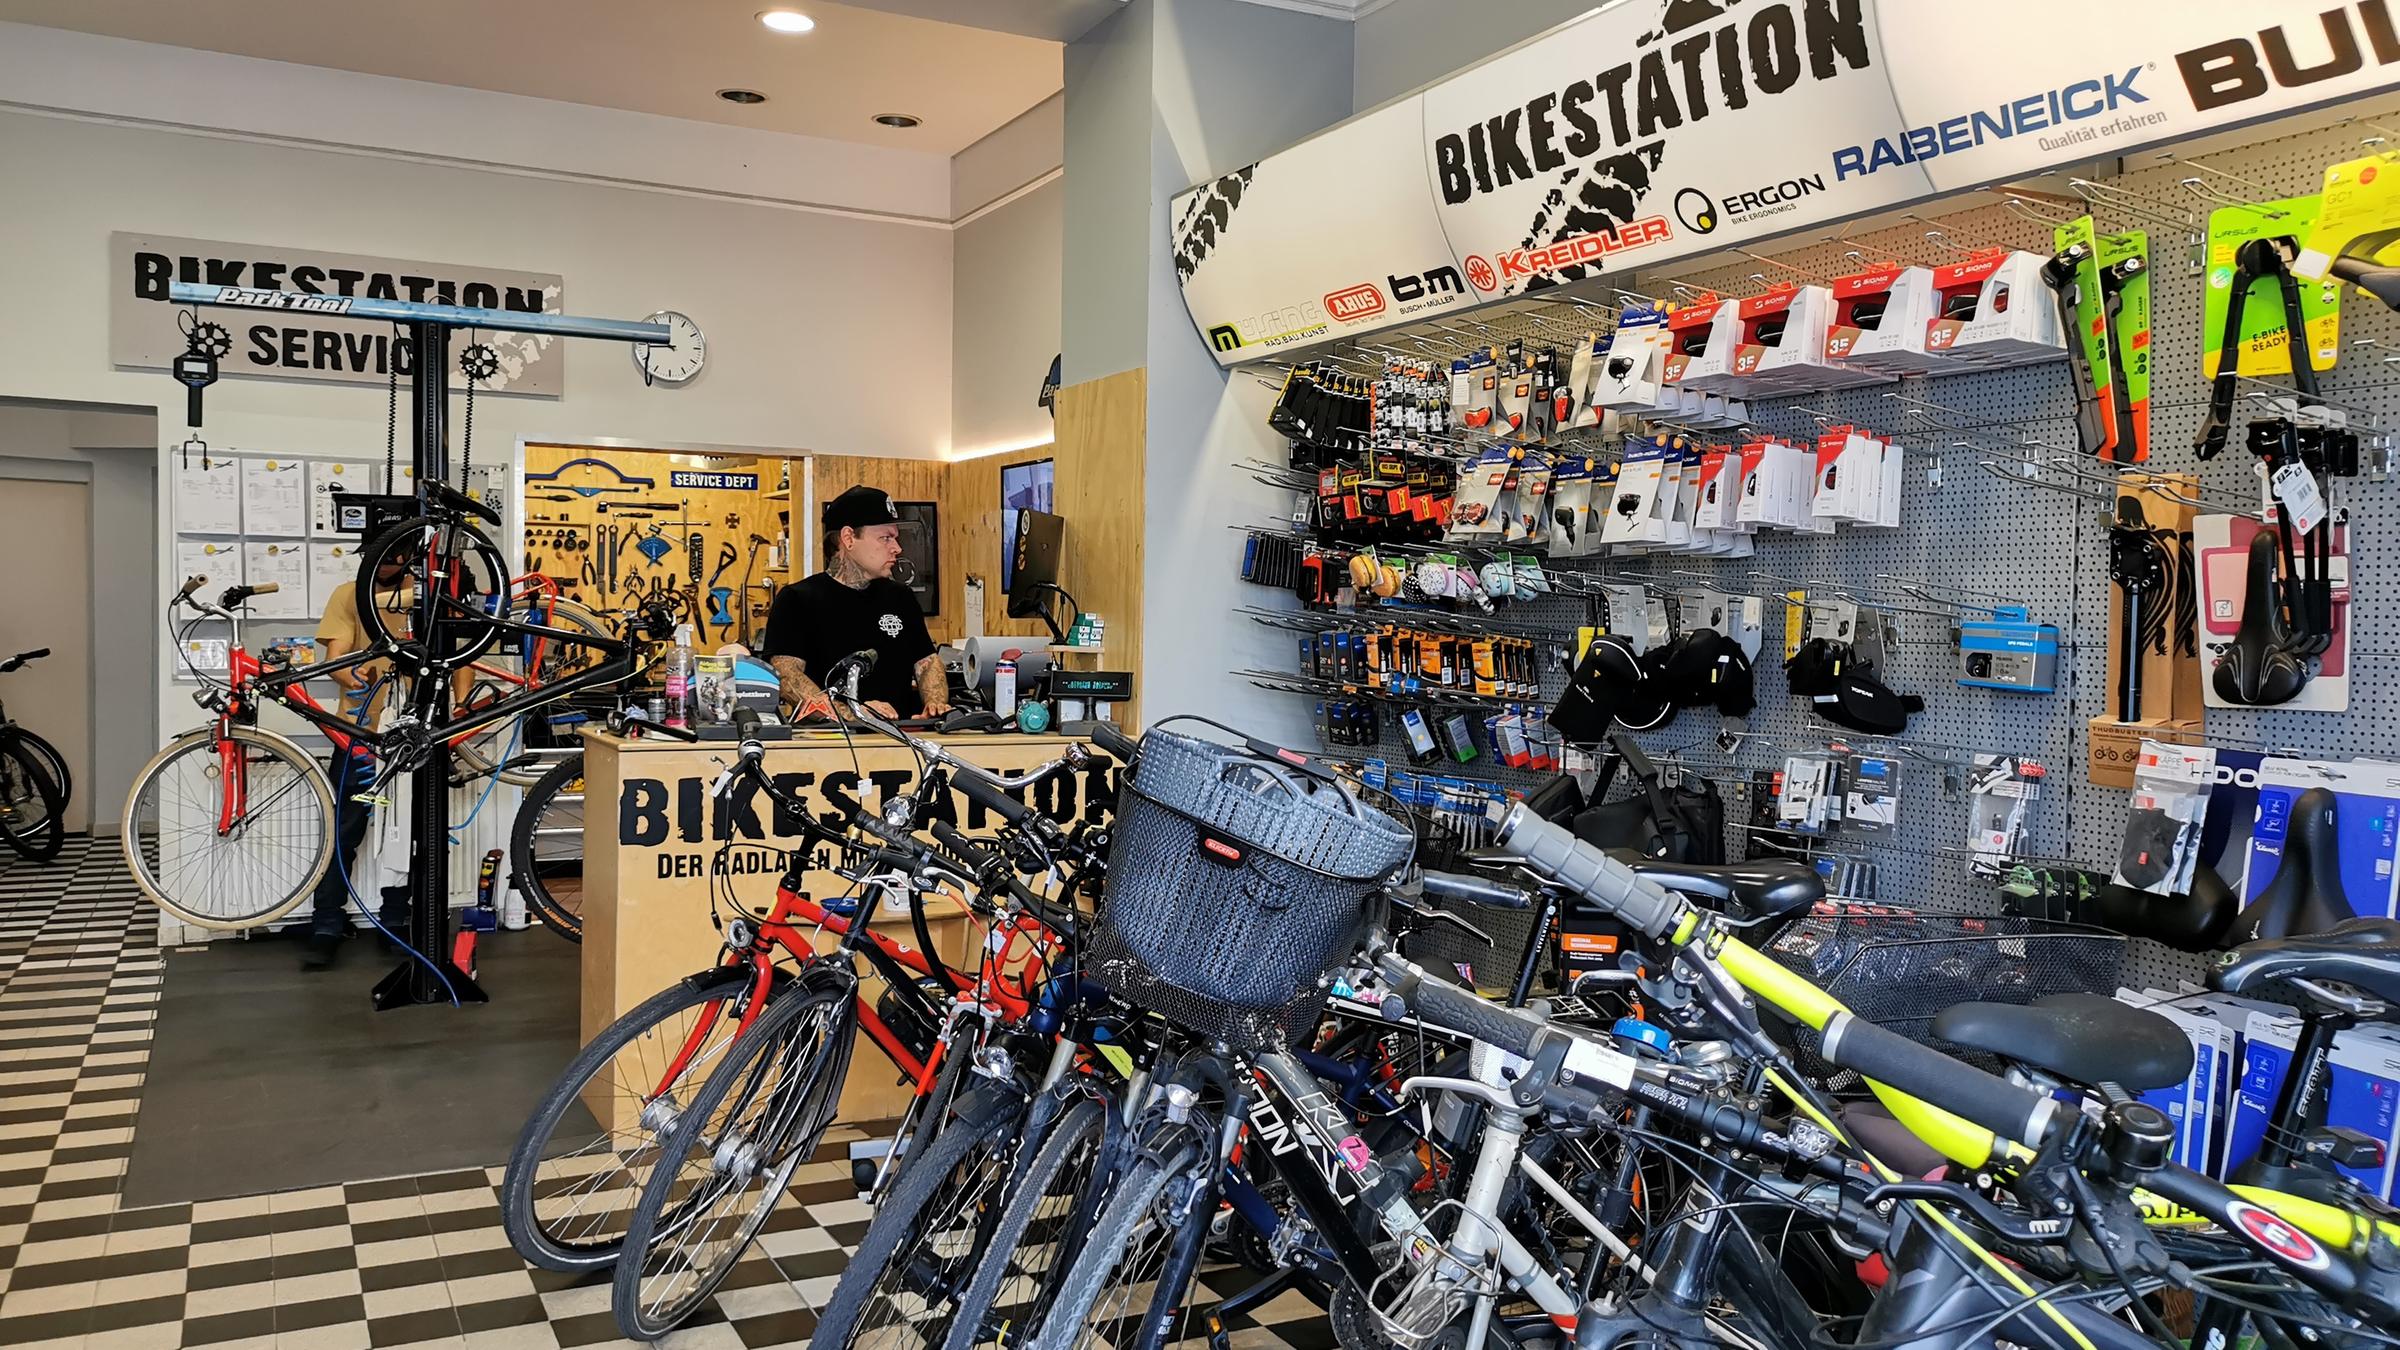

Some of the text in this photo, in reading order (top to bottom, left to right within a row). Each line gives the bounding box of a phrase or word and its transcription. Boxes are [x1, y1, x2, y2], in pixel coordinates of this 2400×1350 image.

[1435, 0, 1870, 204] BIKESTATION
[1833, 64, 2150, 181] RABENEICK
[2038, 109, 2167, 153] Qualität erfahren
[1722, 173, 1826, 216] ERGON
[1731, 202, 1797, 225] BIKE ERGONOMICS
[2214, 227, 2259, 239] URSUS
[1499, 218, 1671, 279] KREIDLER
[2103, 245, 2139, 257] URSUS
[215, 286, 353, 316] Park Tool
[1333, 290, 1378, 317] ABUS
[1399, 295, 1456, 315] BUSCH MÜLLER
[1264, 325, 1330, 349] RAD.BAU.KUNST
[1930, 328, 1951, 347] 35
[2251, 335, 2288, 353] READY
[2252, 325, 2287, 343] E-BIKE
[247, 324, 415, 376] SERVIC
[1829, 338, 1849, 355] 35
[1665, 365, 1681, 380] 35
[1737, 355, 1755, 372] 35
[674, 473, 754, 488] SERVICE DEPT
[657, 853, 704, 879] DER
[714, 848, 831, 876] RADLAEN
[1668, 1075, 1702, 1091] SIGMA
